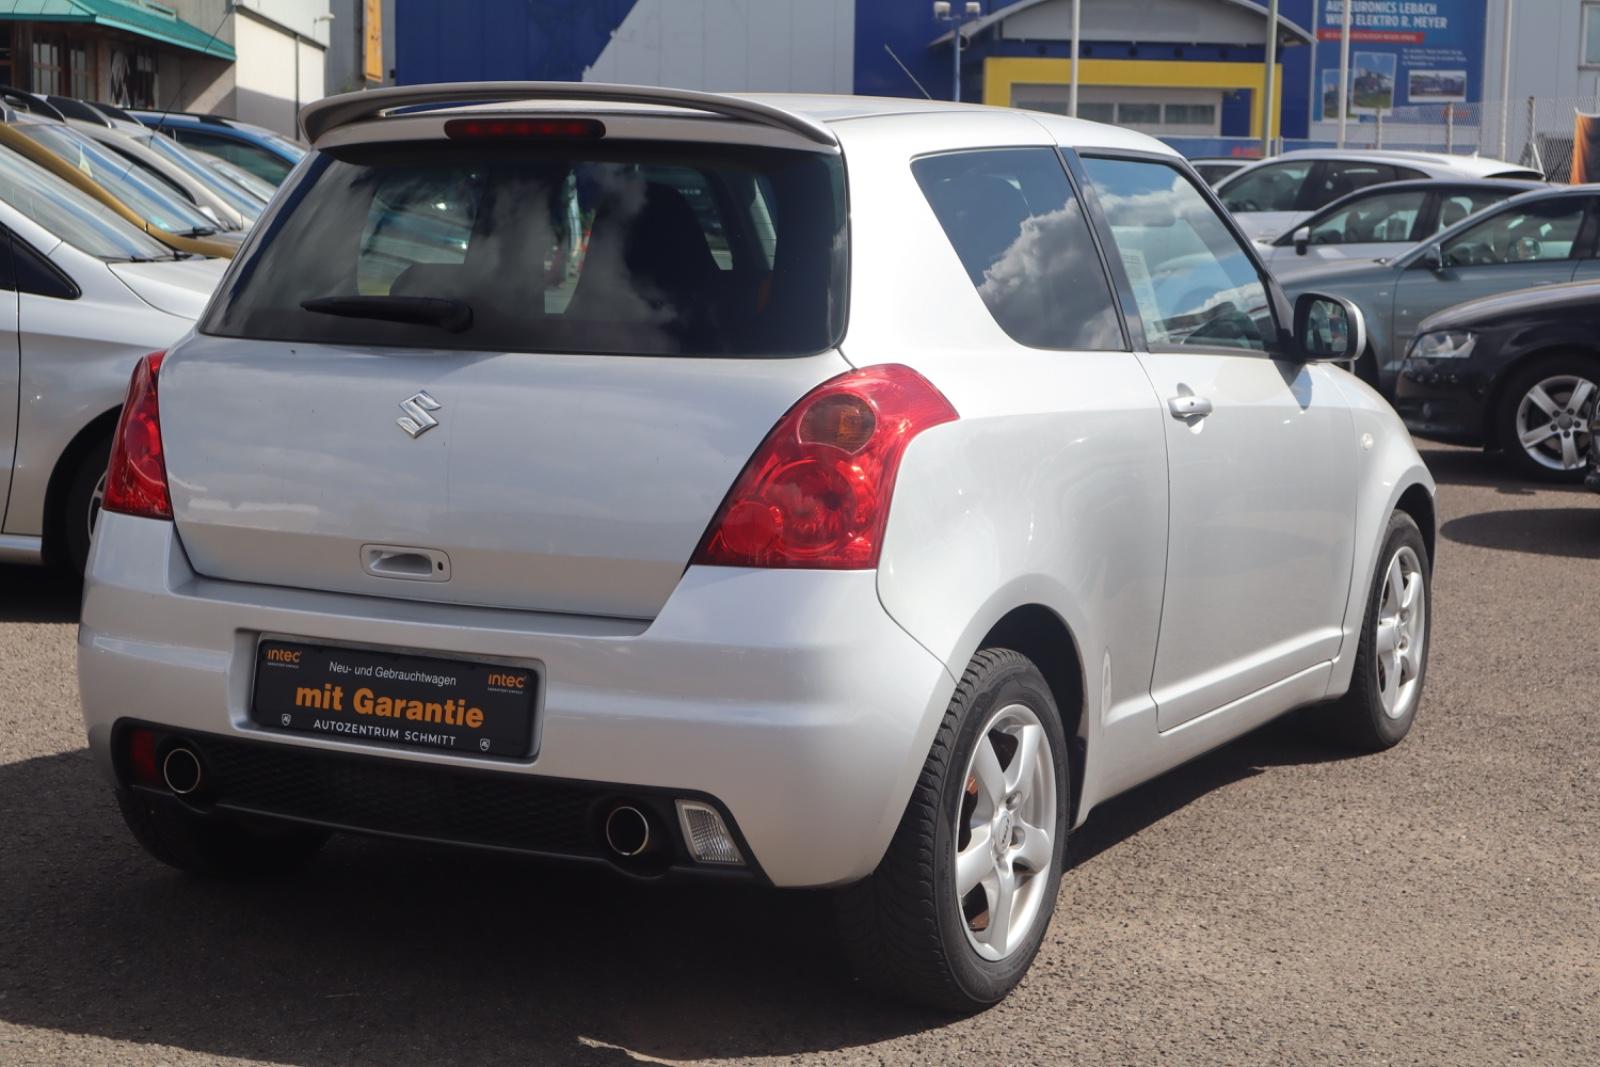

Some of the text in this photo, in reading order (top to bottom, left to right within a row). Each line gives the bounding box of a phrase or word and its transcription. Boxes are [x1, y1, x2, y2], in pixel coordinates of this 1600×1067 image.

[1325, 13, 1354, 26] WID
[1356, 14, 1399, 27] ELEKTRO
[1413, 16, 1448, 29] MEYER
[1399, 3, 1438, 15] LEBACH
[329, 661, 457, 687] Neu- und Gebrauchtwagen
[295, 683, 485, 729] mit Garantie
[313, 719, 456, 746] AUTOZENTRUM SCHMITT
